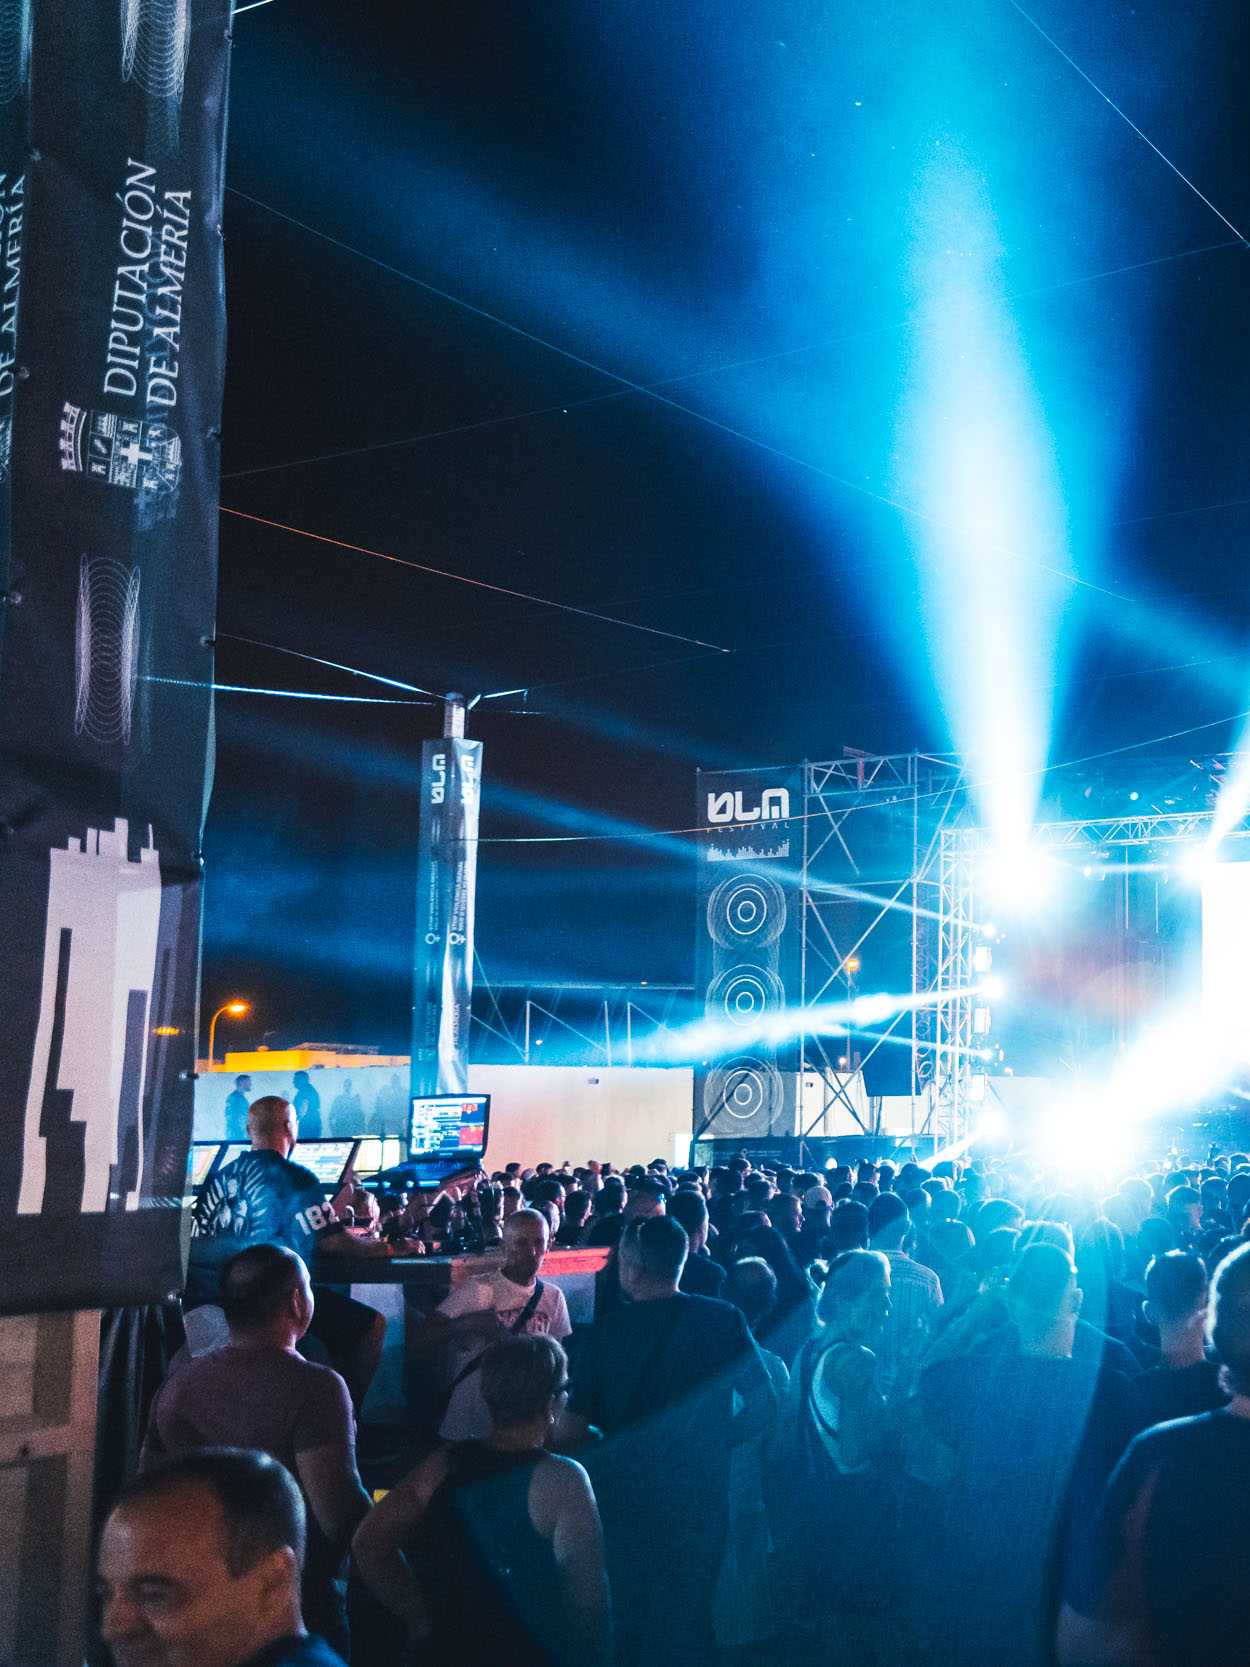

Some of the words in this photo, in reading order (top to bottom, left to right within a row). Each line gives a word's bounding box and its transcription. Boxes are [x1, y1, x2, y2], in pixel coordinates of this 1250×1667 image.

[103, 156, 157, 398] DIPUTACIÓN
[153, 189, 192, 352] ALMERÍA
[147, 356, 179, 407] DE
[295, 1201, 340, 1235] 182
